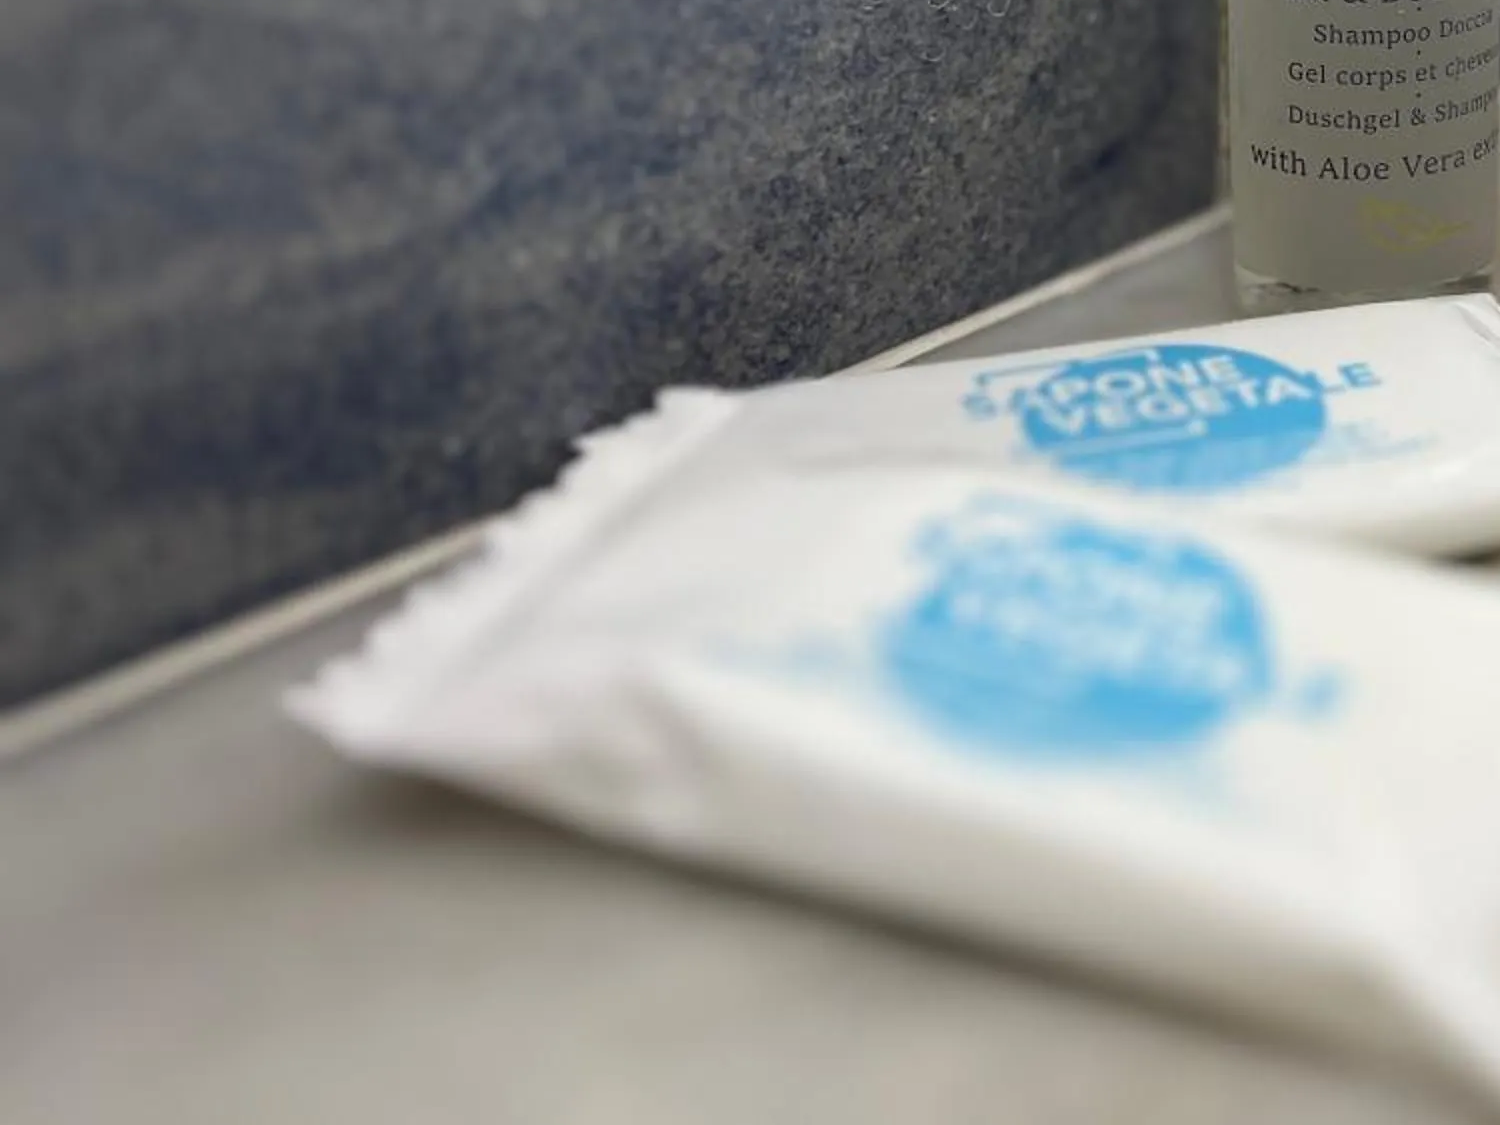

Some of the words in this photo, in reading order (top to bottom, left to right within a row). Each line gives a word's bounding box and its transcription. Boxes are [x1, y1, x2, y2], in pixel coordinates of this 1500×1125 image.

[1313, 23, 1431, 50] Shampoo
[1287, 61, 1326, 84] Gel
[1336, 69, 1408, 91] corps
[1415, 65, 1437, 83] et
[1287, 104, 1400, 135] Duschgel
[1409, 106, 1427, 127] &
[1250, 143, 1307, 178] with
[1318, 157, 1391, 182] Aloe
[1403, 149, 1466, 179] Vera
[962, 353, 1242, 423] SAPONE
